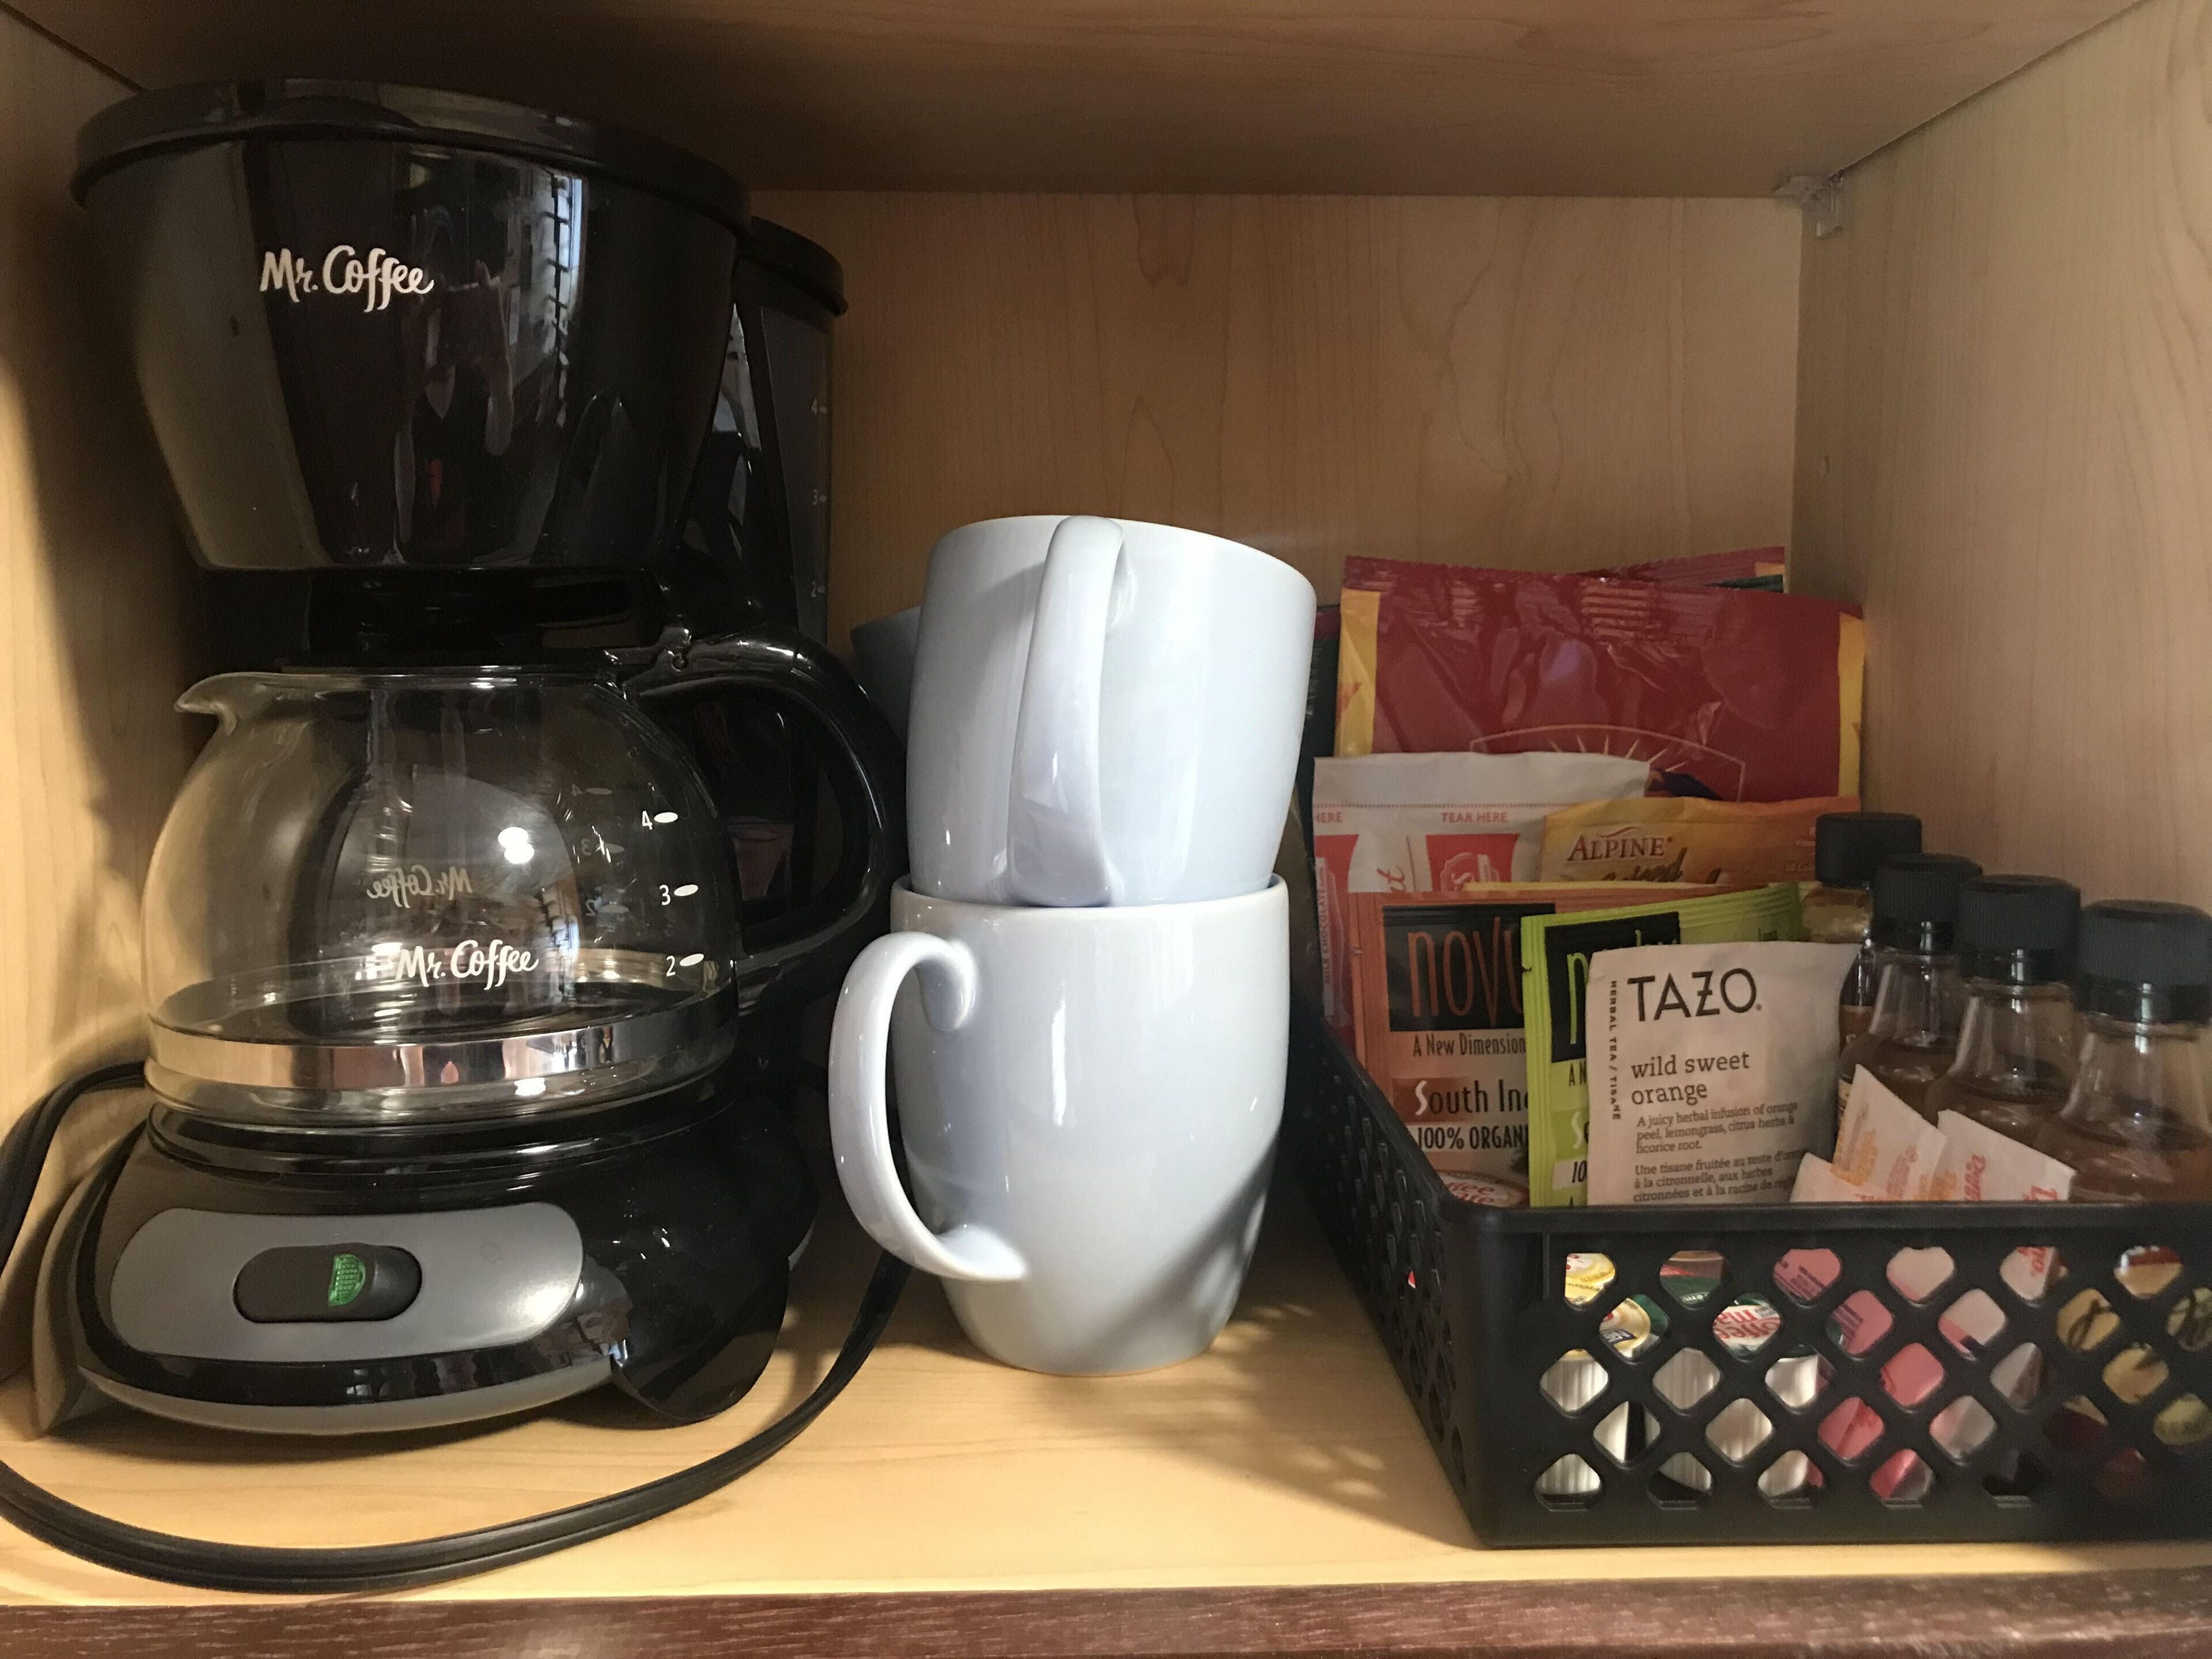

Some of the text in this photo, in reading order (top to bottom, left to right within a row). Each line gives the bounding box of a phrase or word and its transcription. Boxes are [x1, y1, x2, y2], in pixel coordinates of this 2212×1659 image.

[260, 245, 434, 313] Mr. Coffee
[642, 810, 653, 830] 4
[1441, 812, 1508, 823] TEAR HERE
[1567, 835, 1665, 862] ALPINE
[659, 884, 671, 905] 3
[396, 940, 539, 990] Mr. Coffee
[666, 955, 676, 977] 2
[1609, 980, 1617, 1031] HERBAL
[1627, 968, 1757, 1022] TAZO
[1413, 1033, 1526, 1056] A New Dimension
[1609, 1037, 1618, 1061] TEA
[1631, 1051, 1749, 1079] wild sweet
[1415, 1081, 1488, 1116] South
[1610, 1075, 1621, 1120] TISANE
[1631, 1083, 1707, 1106] orange
[1637, 1101, 1798, 1128] A juicy herbal infusion of orange
[1418, 1127, 1464, 1149] 100%
[1637, 1128, 1662, 1141] peel,
[1665, 1123, 1727, 1138] lemongrass,
[1728, 1120, 1755, 1132] citrus
[1572, 1160, 1588, 1184] 10
[1635, 1164, 1657, 1175] Une
[1660, 1162, 1693, 1173] tisane
[1692, 1187, 1704, 1198] et
